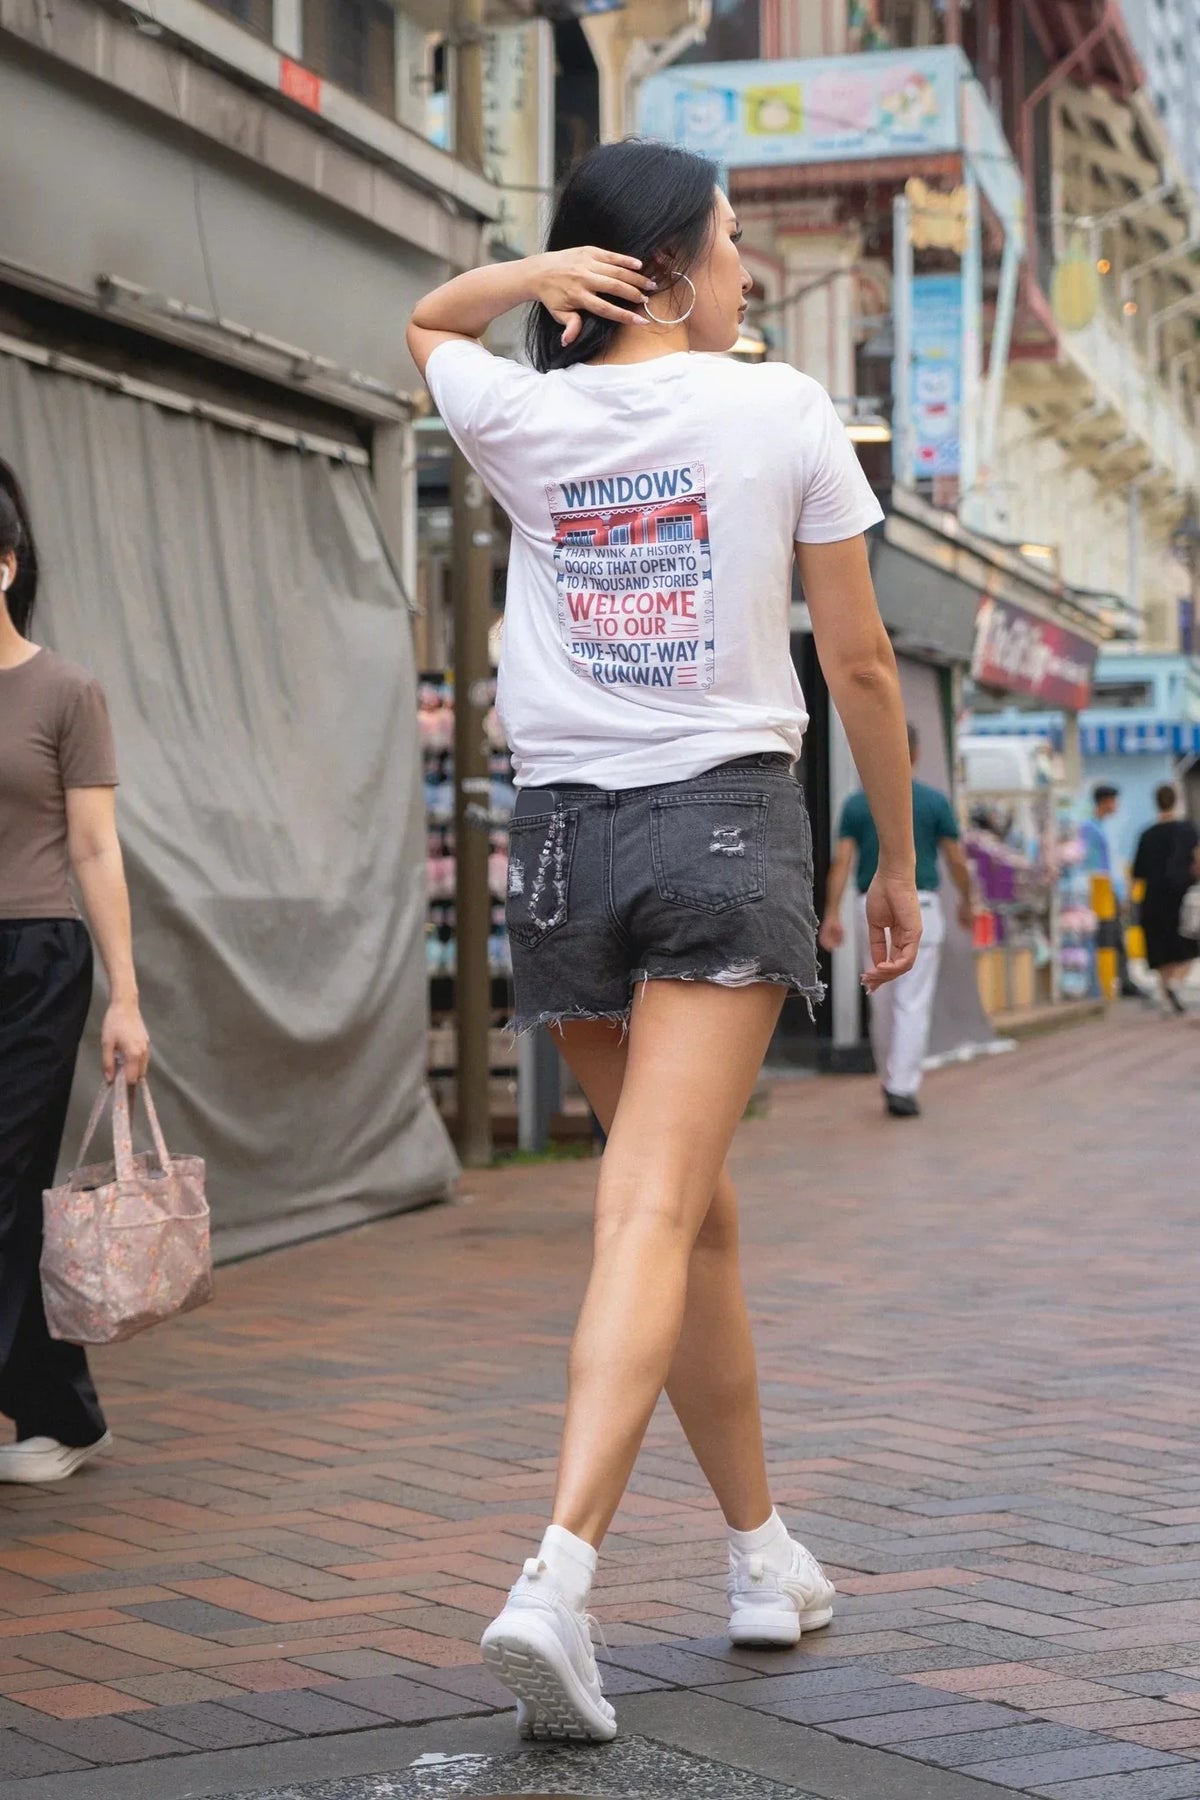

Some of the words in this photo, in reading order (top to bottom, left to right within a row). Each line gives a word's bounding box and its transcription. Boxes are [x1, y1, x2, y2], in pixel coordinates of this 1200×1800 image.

[560, 467, 693, 507] WINDOWS
[565, 547, 590, 558] THAT
[594, 547, 626, 558] WINK
[630, 547, 642, 557] AT
[647, 544, 695, 557] HISTORY.
[565, 561, 603, 575] DOORS
[606, 561, 637, 575] THAT
[640, 558, 675, 574] OPEN
[678, 556, 697, 571] TO
[567, 576, 579, 589] TO
[581, 577, 588, 589] A
[589, 577, 650, 591] THOUSAND
[653, 574, 698, 589] STORIES
[566, 590, 696, 622] WELCOME
[593, 618, 618, 637] TO
[624, 617, 667, 636] OUR
[592, 662, 675, 687] RUNWAY
